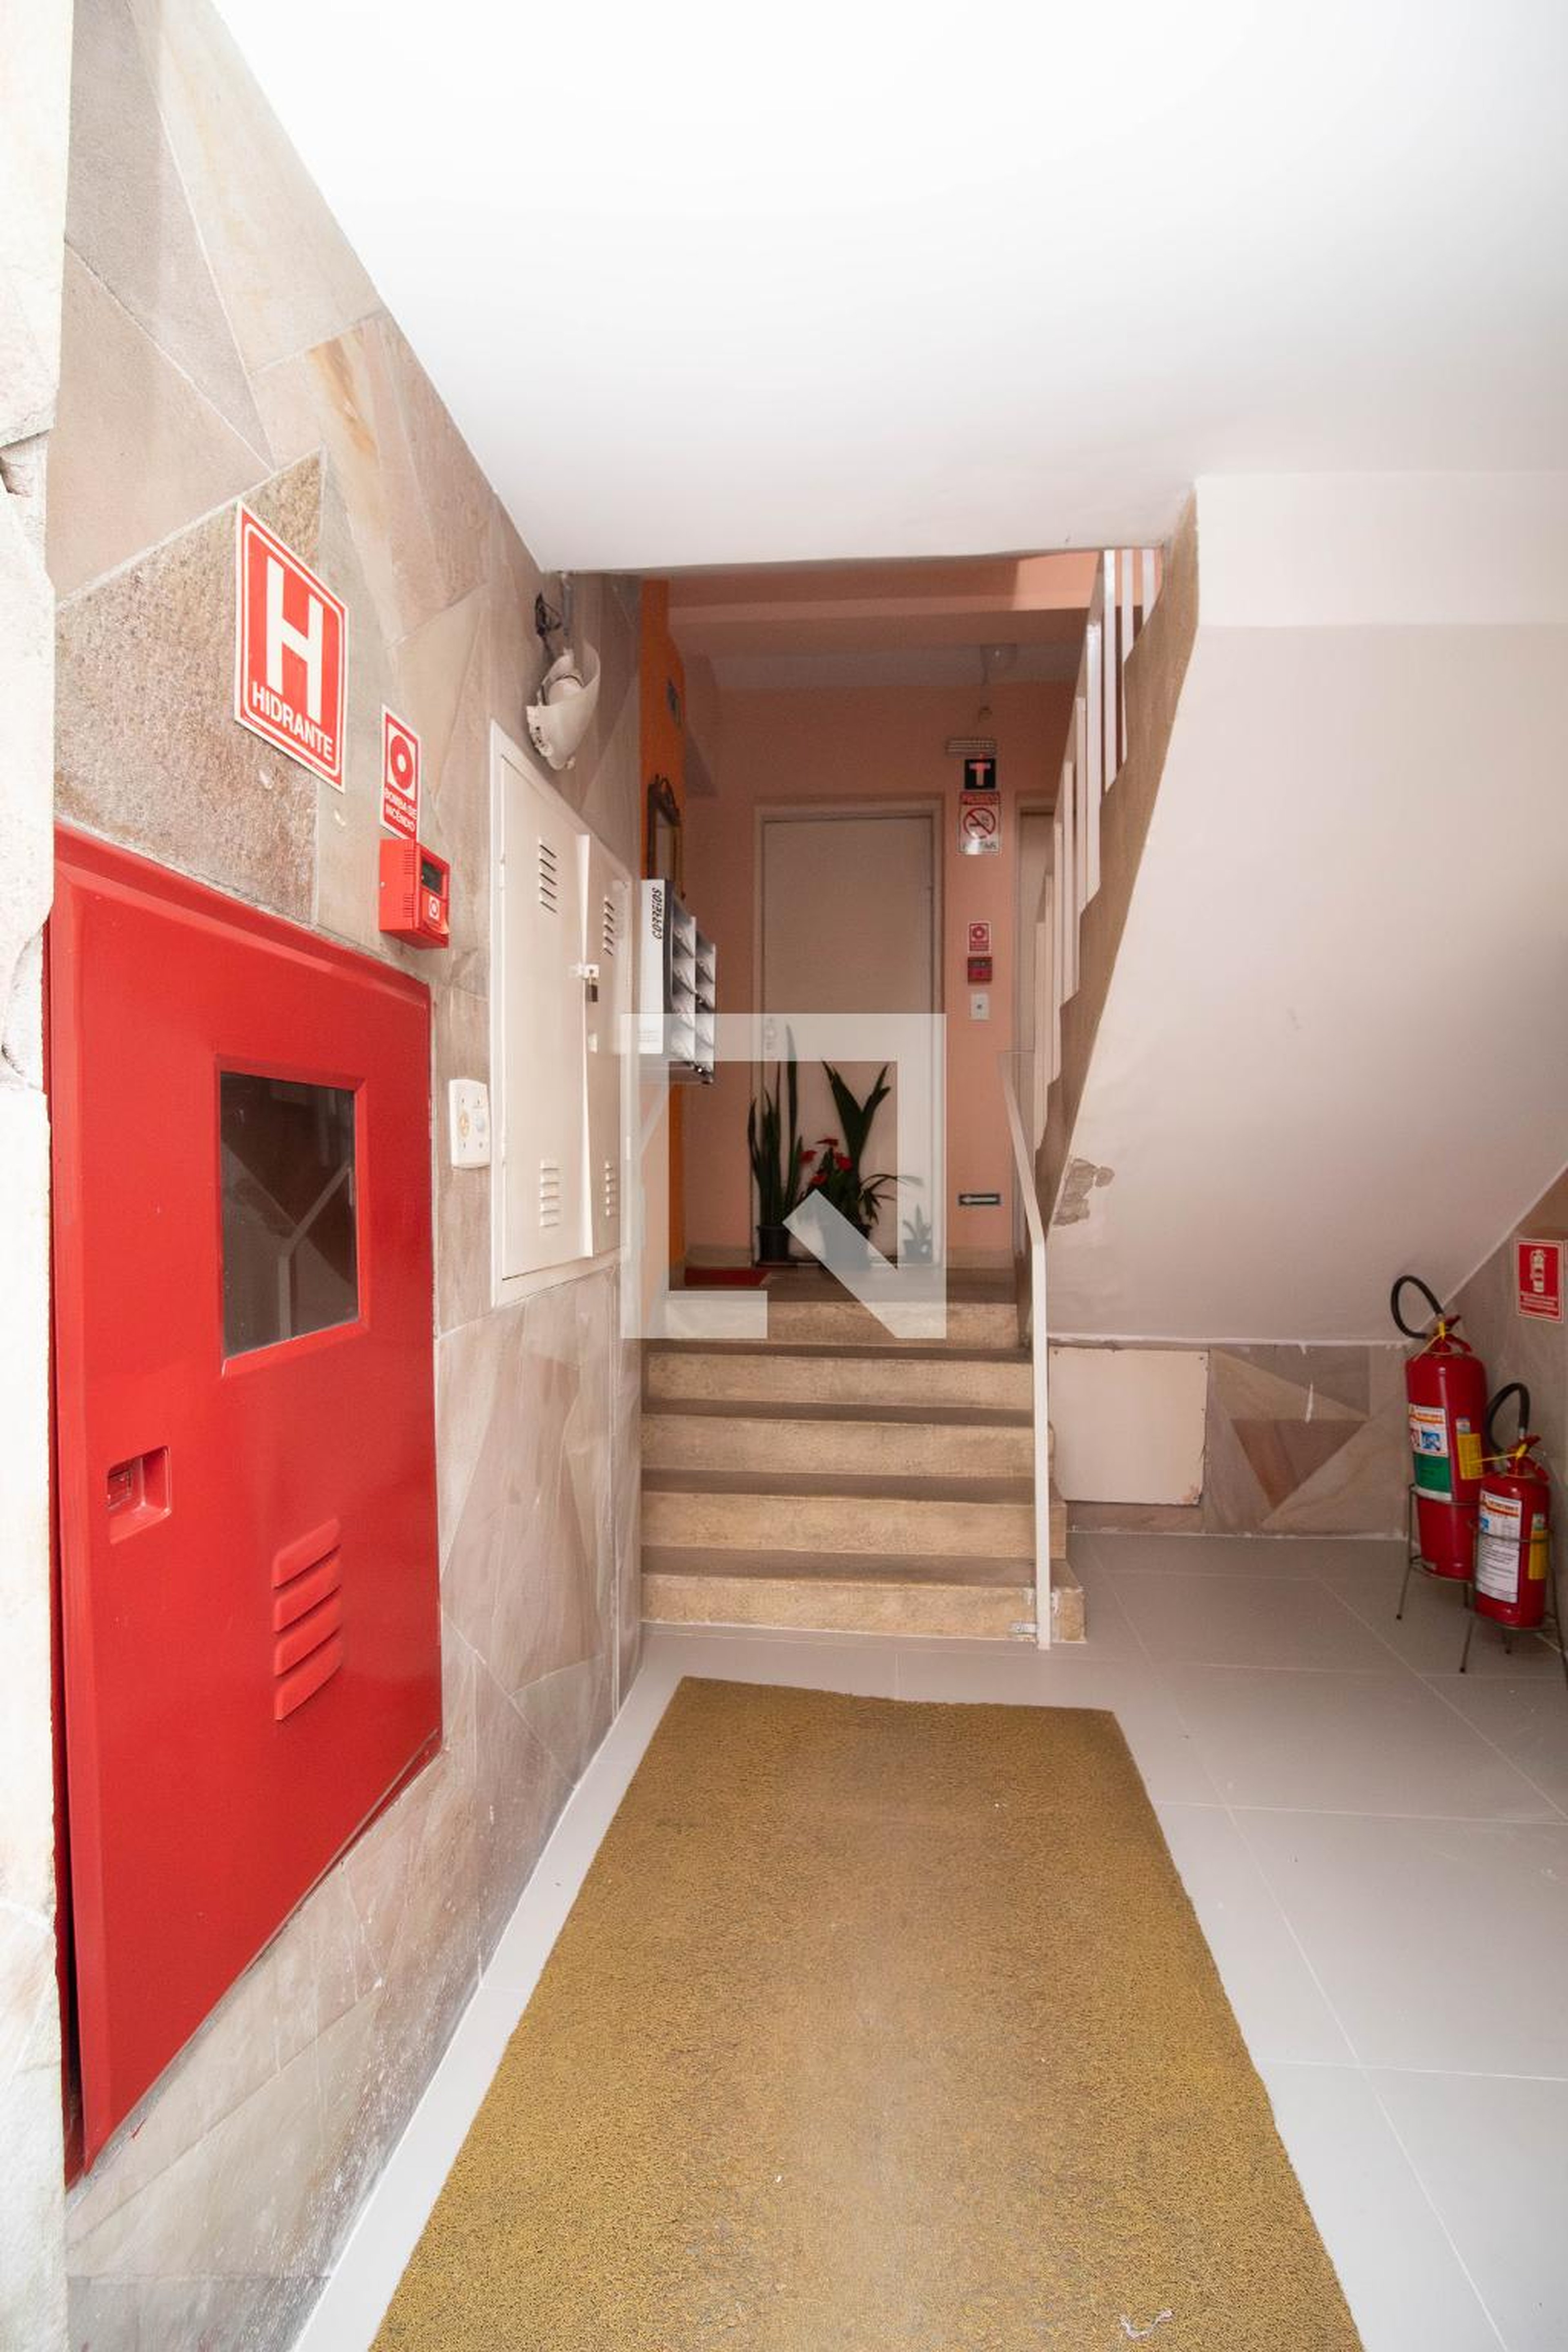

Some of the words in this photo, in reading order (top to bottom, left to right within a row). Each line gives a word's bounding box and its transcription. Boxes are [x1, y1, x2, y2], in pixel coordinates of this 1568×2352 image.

[267, 555, 324, 726] H
[252, 681, 333, 761] HIDRANTE
[969, 762, 991, 786] T
